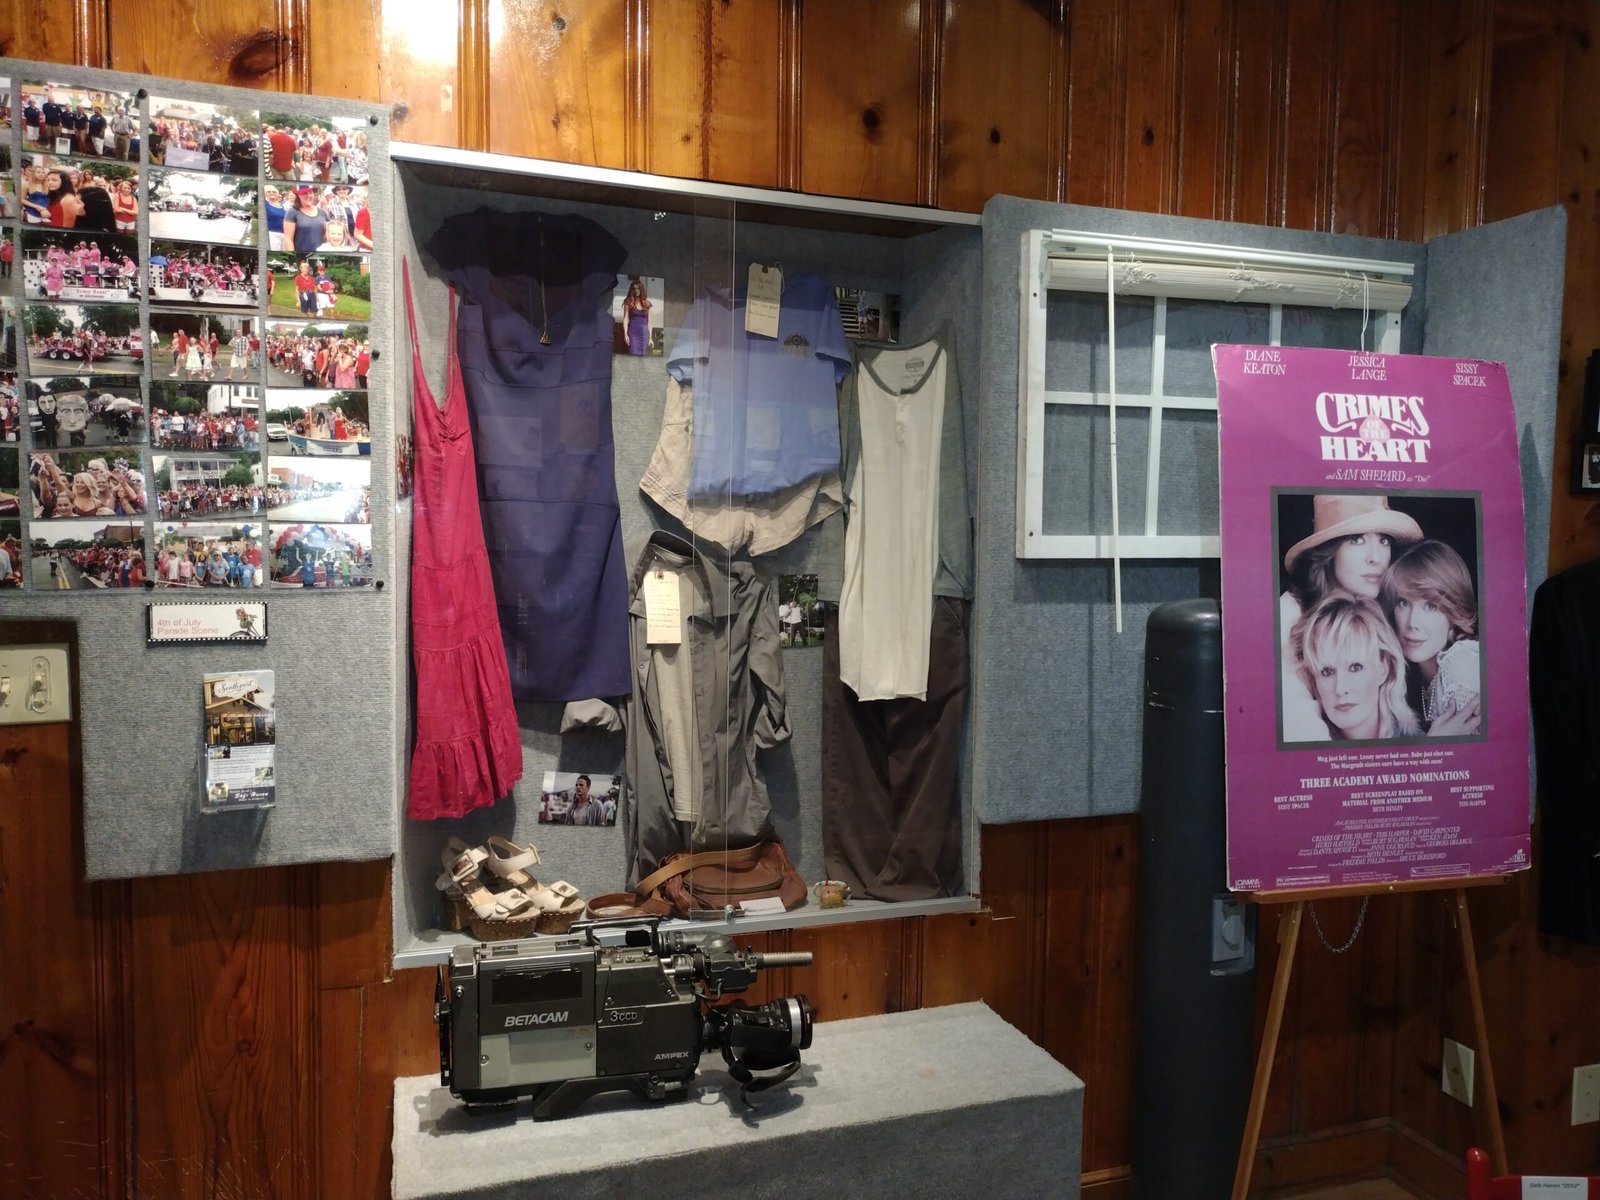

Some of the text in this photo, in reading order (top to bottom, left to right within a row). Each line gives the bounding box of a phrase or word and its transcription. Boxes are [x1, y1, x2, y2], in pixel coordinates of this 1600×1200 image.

[1246, 349, 1281, 362] DIANE
[1348, 355, 1385, 368] JESSICA
[1244, 362, 1286, 376] KEATON
[1351, 369, 1387, 381] LANGE
[1456, 363, 1479, 375] SISSY
[1453, 375, 1486, 387] SPACEK
[1315, 392, 1430, 436] CRIMES
[1320, 436, 1432, 463] HEART
[1336, 468, 1358, 481] SAM
[1360, 469, 1406, 482] SHEPARD
[157, 619, 171, 627] 4th
[184, 618, 202, 628] July
[157, 626, 219, 635] Parade Scene
[1300, 770, 1470, 789] THREE ACADEMY AWARD NOMINATIONS
[1365, 790, 1398, 799] SCREENPLAY
[1463, 784, 1495, 793] SUPPORTING
[1289, 794, 1313, 802] ACTRESS
[504, 1011, 569, 1027] BETACAM
[654, 1051, 689, 1061] AMPEX
